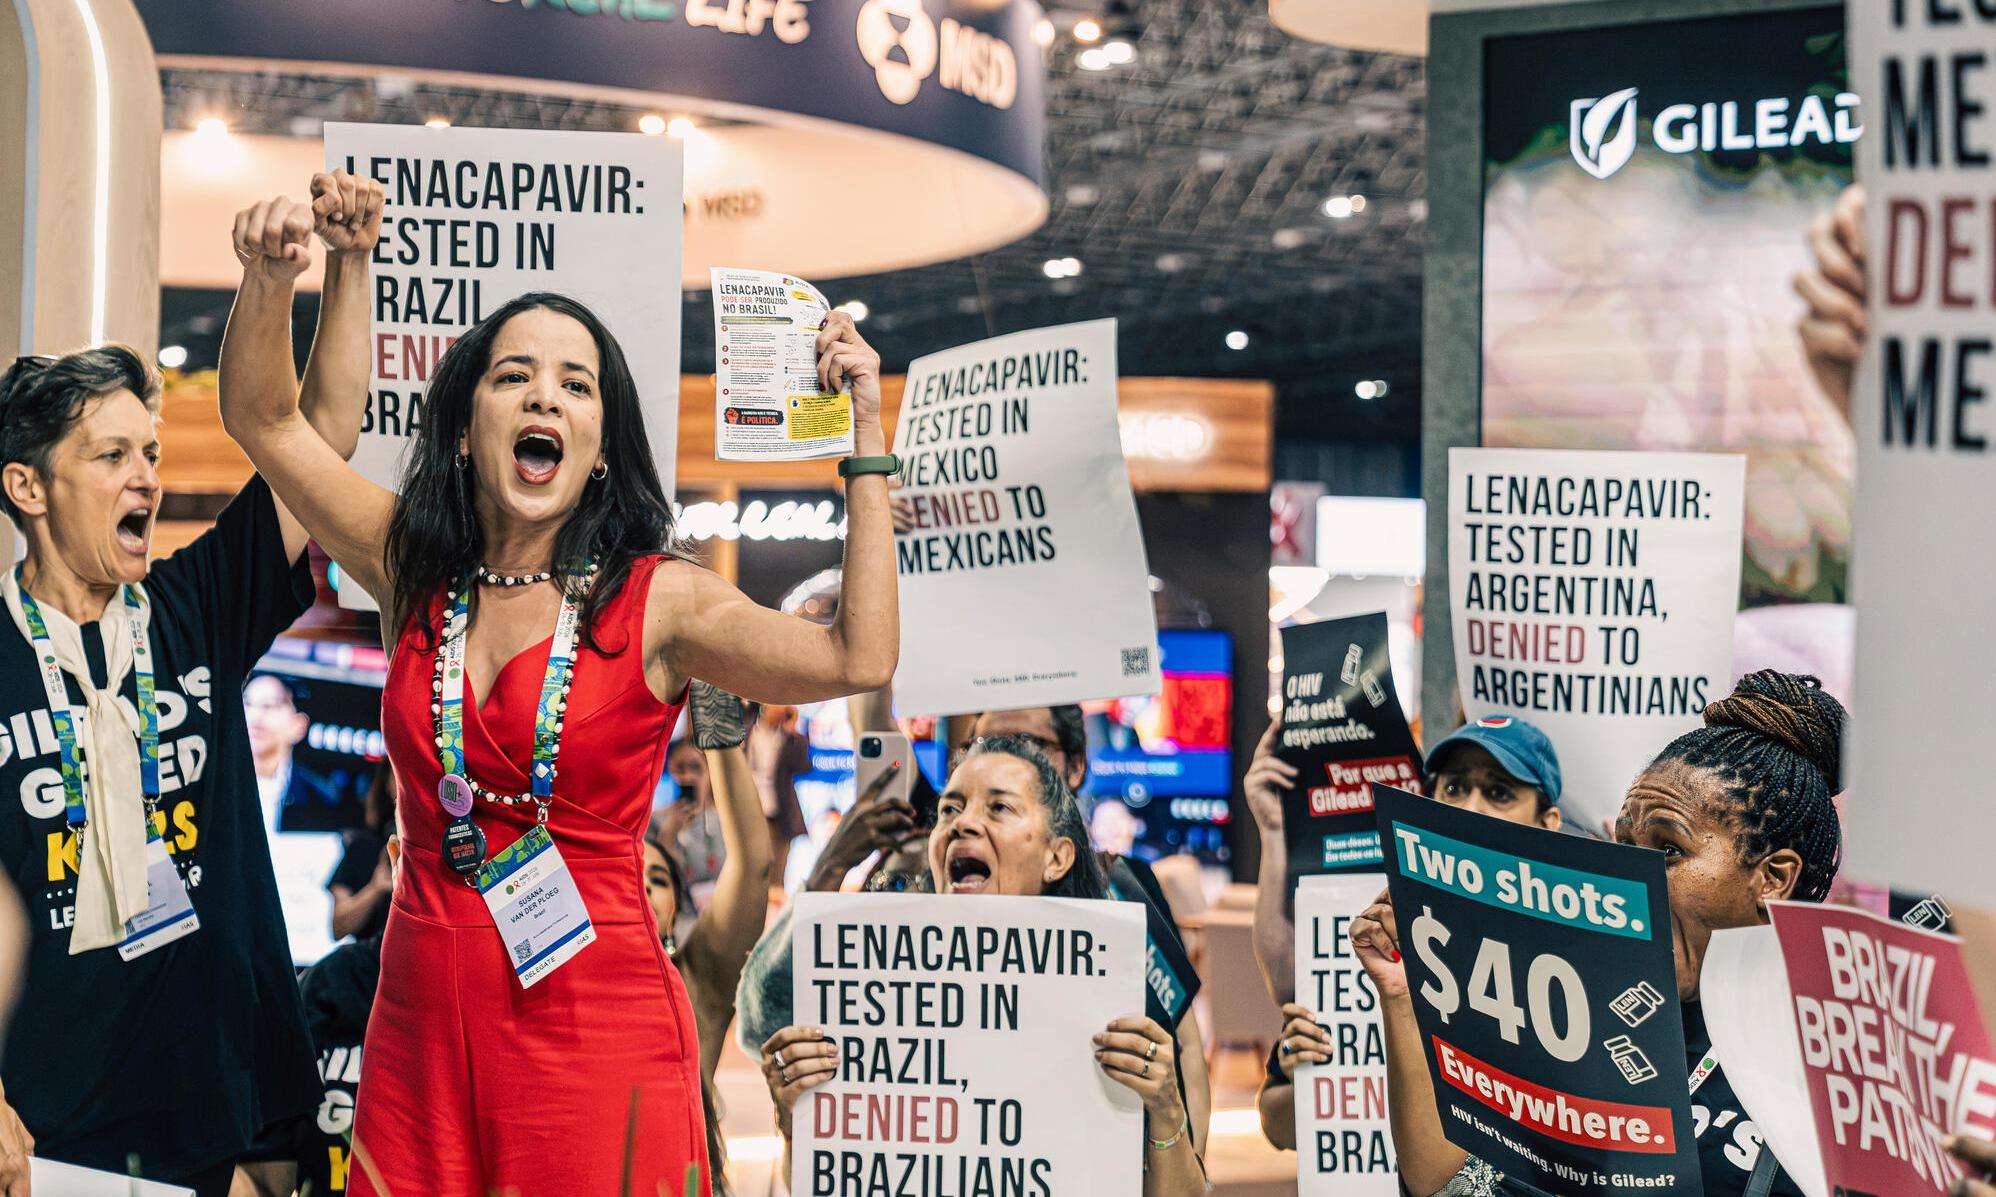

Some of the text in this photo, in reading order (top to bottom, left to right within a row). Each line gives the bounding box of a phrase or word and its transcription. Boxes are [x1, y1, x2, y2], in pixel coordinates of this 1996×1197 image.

[940, 17, 1017, 109] MSD
[1652, 92, 1864, 153] GILEAD
[1883, 52, 1990, 169] ME
[372, 217, 555, 271] ESTED IN
[1886, 196, 1996, 309] DE
[376, 275, 481, 326] RAZIL
[720, 284, 785, 297] LENACAPAVIR
[721, 295, 738, 303] PODE
[755, 297, 788, 305] PRODUZIDO
[723, 304, 777, 315] NO BRASIL!
[377, 333, 460, 382] ENI
[910, 348, 1089, 410] LENACAPAVIR:
[360, 390, 424, 437] BRA
[1883, 336, 1993, 451] ME
[905, 397, 1029, 448] TESTED IN
[900, 445, 998, 487] MEXICO
[904, 484, 1046, 529] ENIED TO
[1466, 474, 1711, 520] LENACAPAVIR:
[898, 525, 1056, 575] MEXICANS
[1465, 523, 1638, 567] TESTED IN
[1466, 571, 1668, 623] ARGENTINA,
[1467, 619, 1639, 666] DENIED TO
[1285, 694, 1347, 723] não está
[1287, 672, 1323, 699] O HIV
[1473, 665, 1710, 716] ARGENTINIANS
[1283, 718, 1376, 749] esperando.
[1311, 783, 1371, 813] Gilead
[1328, 763, 1412, 786] Por que a
[518, 886, 544, 908] SUSANA
[1395, 828, 1645, 932] Two shots.
[510, 886, 560, 924] VAN DER PLOEG
[1908, 904, 1932, 925] LEN
[125, 941, 145, 955] MEDIA
[813, 923, 1107, 977] LENACAPAVIR:
[1312, 916, 1351, 960] LE
[524, 955, 556, 981] DELEGATE
[1311, 969, 1376, 1013] TES
[1411, 905, 1591, 1063] $40
[812, 979, 1019, 1031] TESTED IN
[1614, 993, 1636, 1011] LEN
[823, 1036, 968, 1093] RAZIL,
[316, 1089, 354, 1135] G
[1314, 1076, 1386, 1121] DEN
[1440, 1044, 1665, 1145] Everywhere.
[813, 1091, 1023, 1147] DENIED TO
[1316, 1130, 1397, 1174] BRA
[1451, 1104, 1676, 1188] HIV isn't waiting. Why is Gilead?
[812, 1150, 1052, 1197] BRAZILIANS
